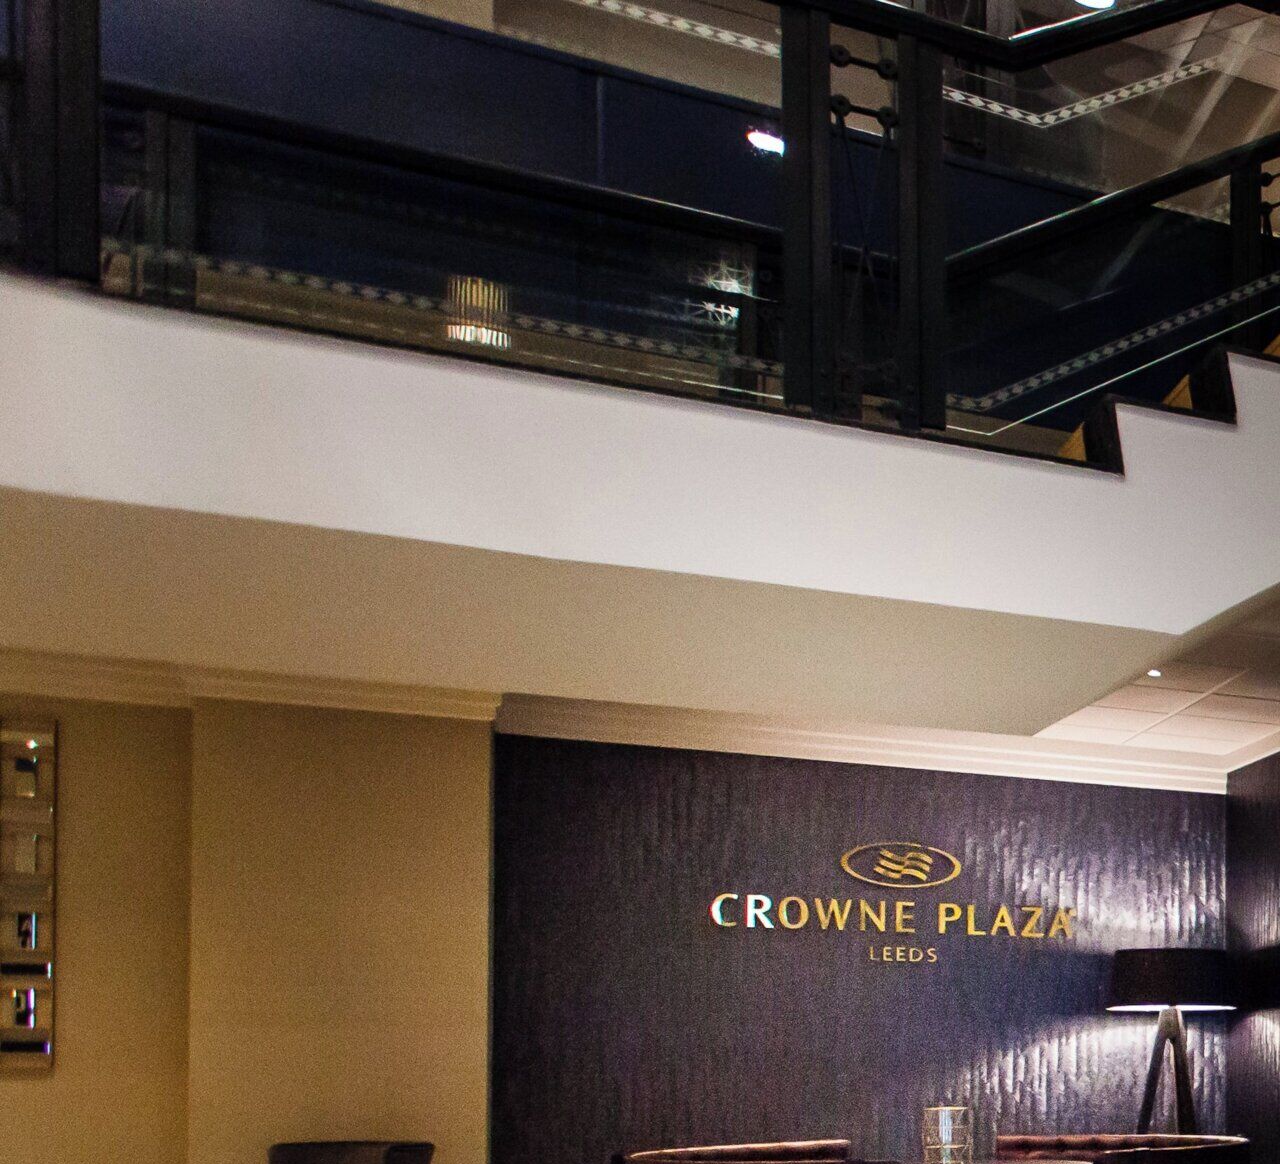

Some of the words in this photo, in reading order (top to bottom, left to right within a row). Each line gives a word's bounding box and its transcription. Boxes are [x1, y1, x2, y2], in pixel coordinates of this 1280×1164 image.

[709, 893, 916, 933] CROWNE
[937, 902, 1074, 939] PLAZA
[869, 946, 938, 963] LEEDS
